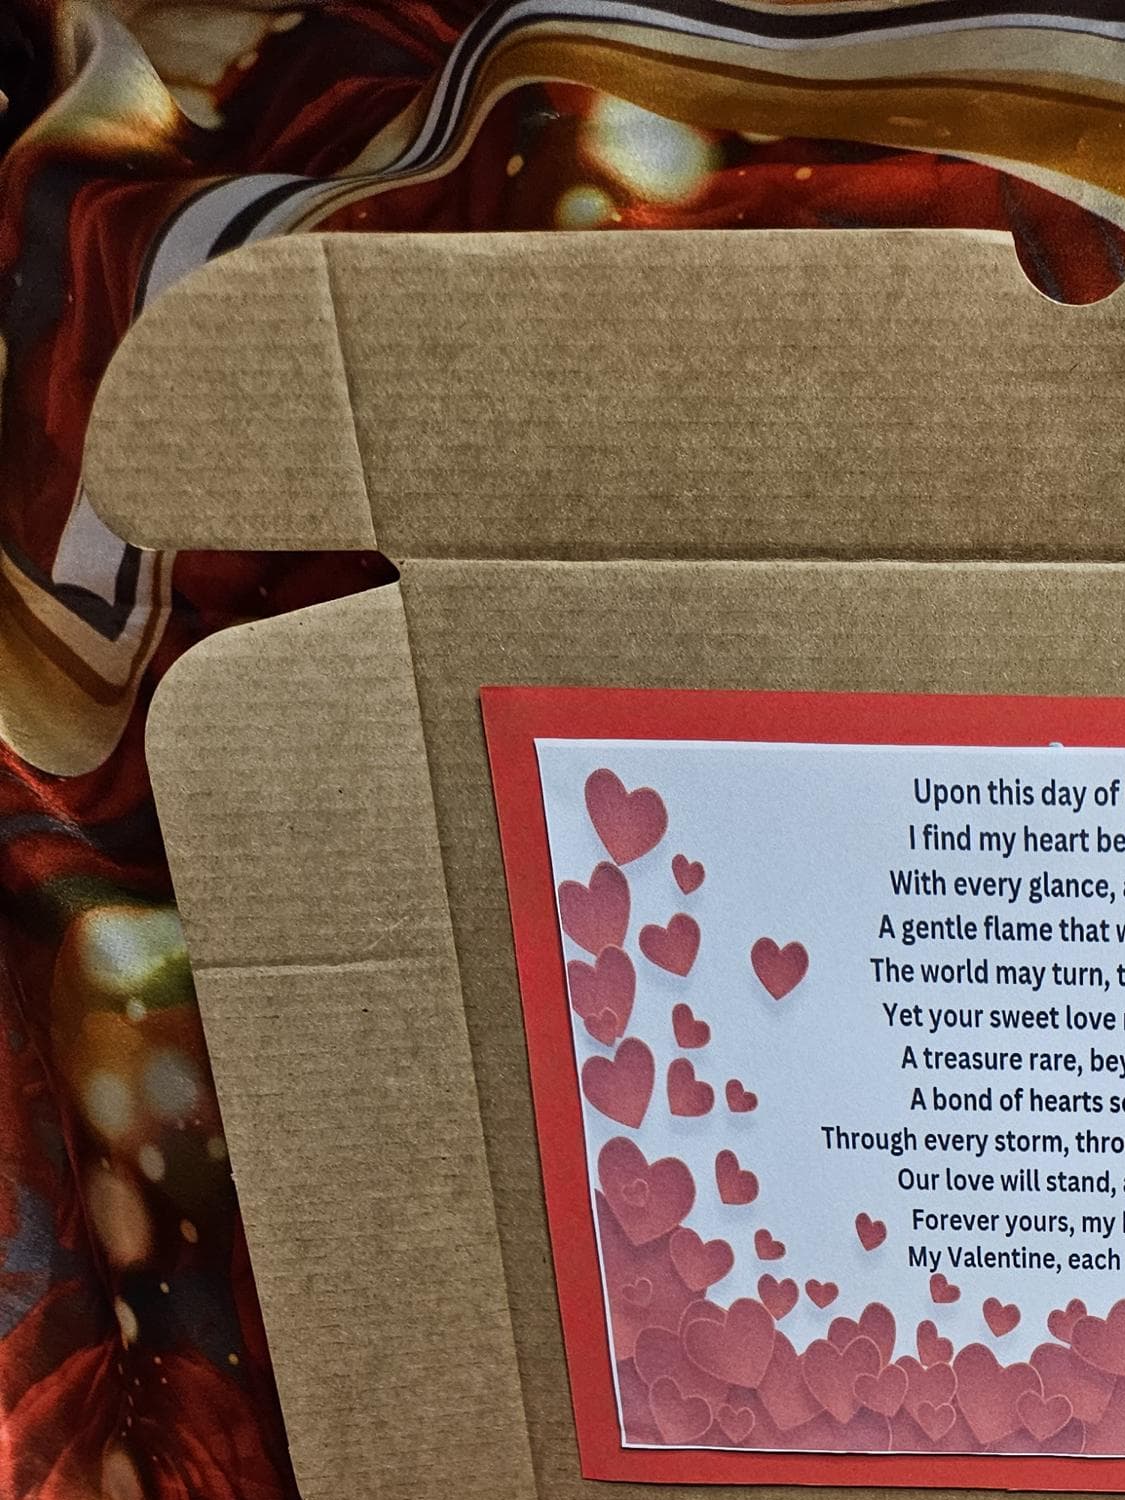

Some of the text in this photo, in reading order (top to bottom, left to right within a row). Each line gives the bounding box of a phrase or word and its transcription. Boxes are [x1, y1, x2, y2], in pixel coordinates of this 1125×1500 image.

[914, 777, 981, 812] Upon
[987, 777, 1035, 806] this
[1041, 778, 1087, 814] day
[1094, 778, 1121, 807] of
[909, 824, 916, 850] I
[922, 823, 972, 851] find
[979, 831, 1017, 859] my
[1023, 824, 1090, 853] heart
[889, 868, 947, 896] With
[953, 876, 1023, 904] every
[1028, 870, 1116, 905] glance,
[878, 914, 896, 939] A
[901, 914, 978, 946] gentle
[983, 914, 1053, 942] flame
[1058, 916, 1110, 943] that
[869, 956, 915, 983] The
[920, 957, 989, 985] world
[996, 965, 1046, 992] may
[1051, 962, 1111, 993] turn,
[882, 1002, 924, 1027] Yet
[928, 1008, 984, 1034] your
[989, 1006, 1060, 1030] sweet
[1066, 1004, 1116, 1031] love
[901, 1045, 918, 1069] A
[922, 1047, 1023, 1071] treasure
[1029, 1052, 1083, 1078] rare,
[910, 1087, 927, 1111] A
[932, 1086, 993, 1112] bond
[999, 1087, 1024, 1112] of
[1029, 1087, 1104, 1113] hearts
[820, 1125, 917, 1157] Through
[924, 1133, 989, 1158] every
[994, 1130, 1069, 1158] storm,
[897, 1167, 940, 1191] Our
[945, 1167, 995, 1192] love
[1000, 1168, 1041, 1192] will
[1046, 1169, 1117, 1199] stand,
[912, 1208, 1000, 1232] Forever
[1005, 1214, 1075, 1238] yours,
[1082, 1215, 1116, 1239] my
[908, 1245, 942, 1274] My
[947, 1245, 1062, 1275] Valentine,
[1068, 1247, 1121, 1271] each
